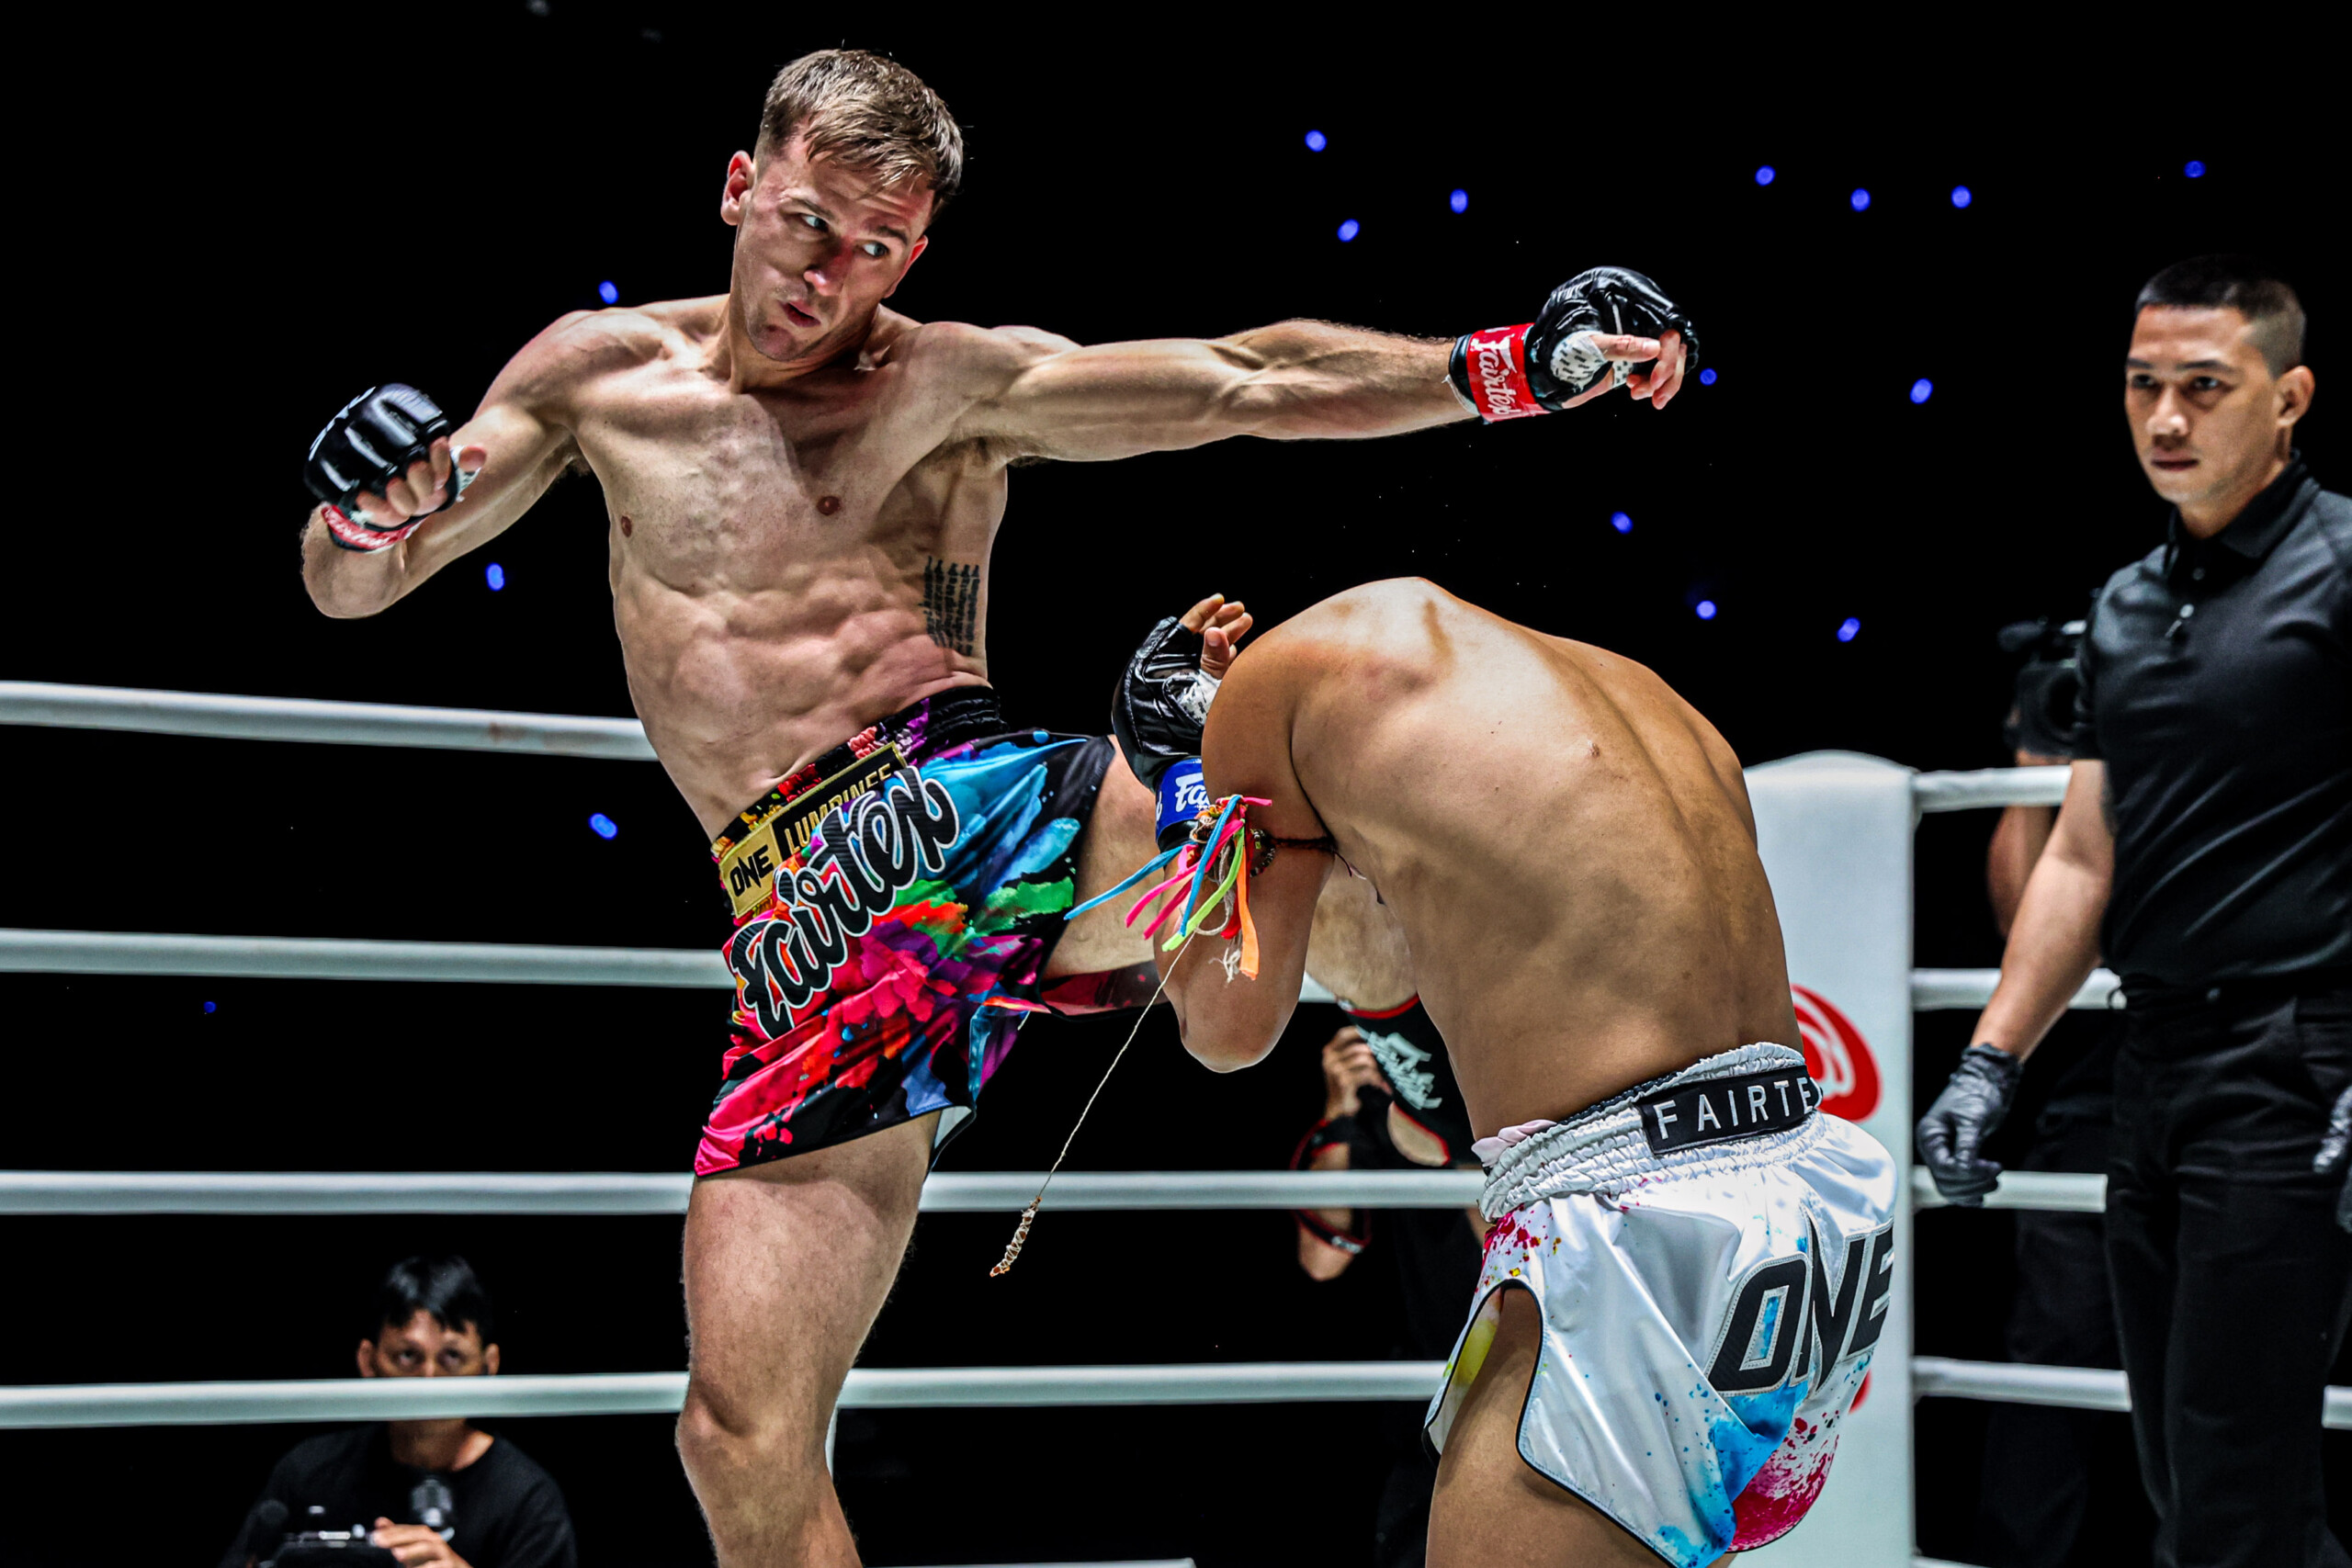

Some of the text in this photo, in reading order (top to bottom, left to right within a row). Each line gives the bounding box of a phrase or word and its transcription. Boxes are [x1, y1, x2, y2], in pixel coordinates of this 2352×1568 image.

[729, 845, 774, 897] ONE
[1653, 1077, 1814, 1140] FAIRTE
[1706, 1201, 1894, 1393] ONE
